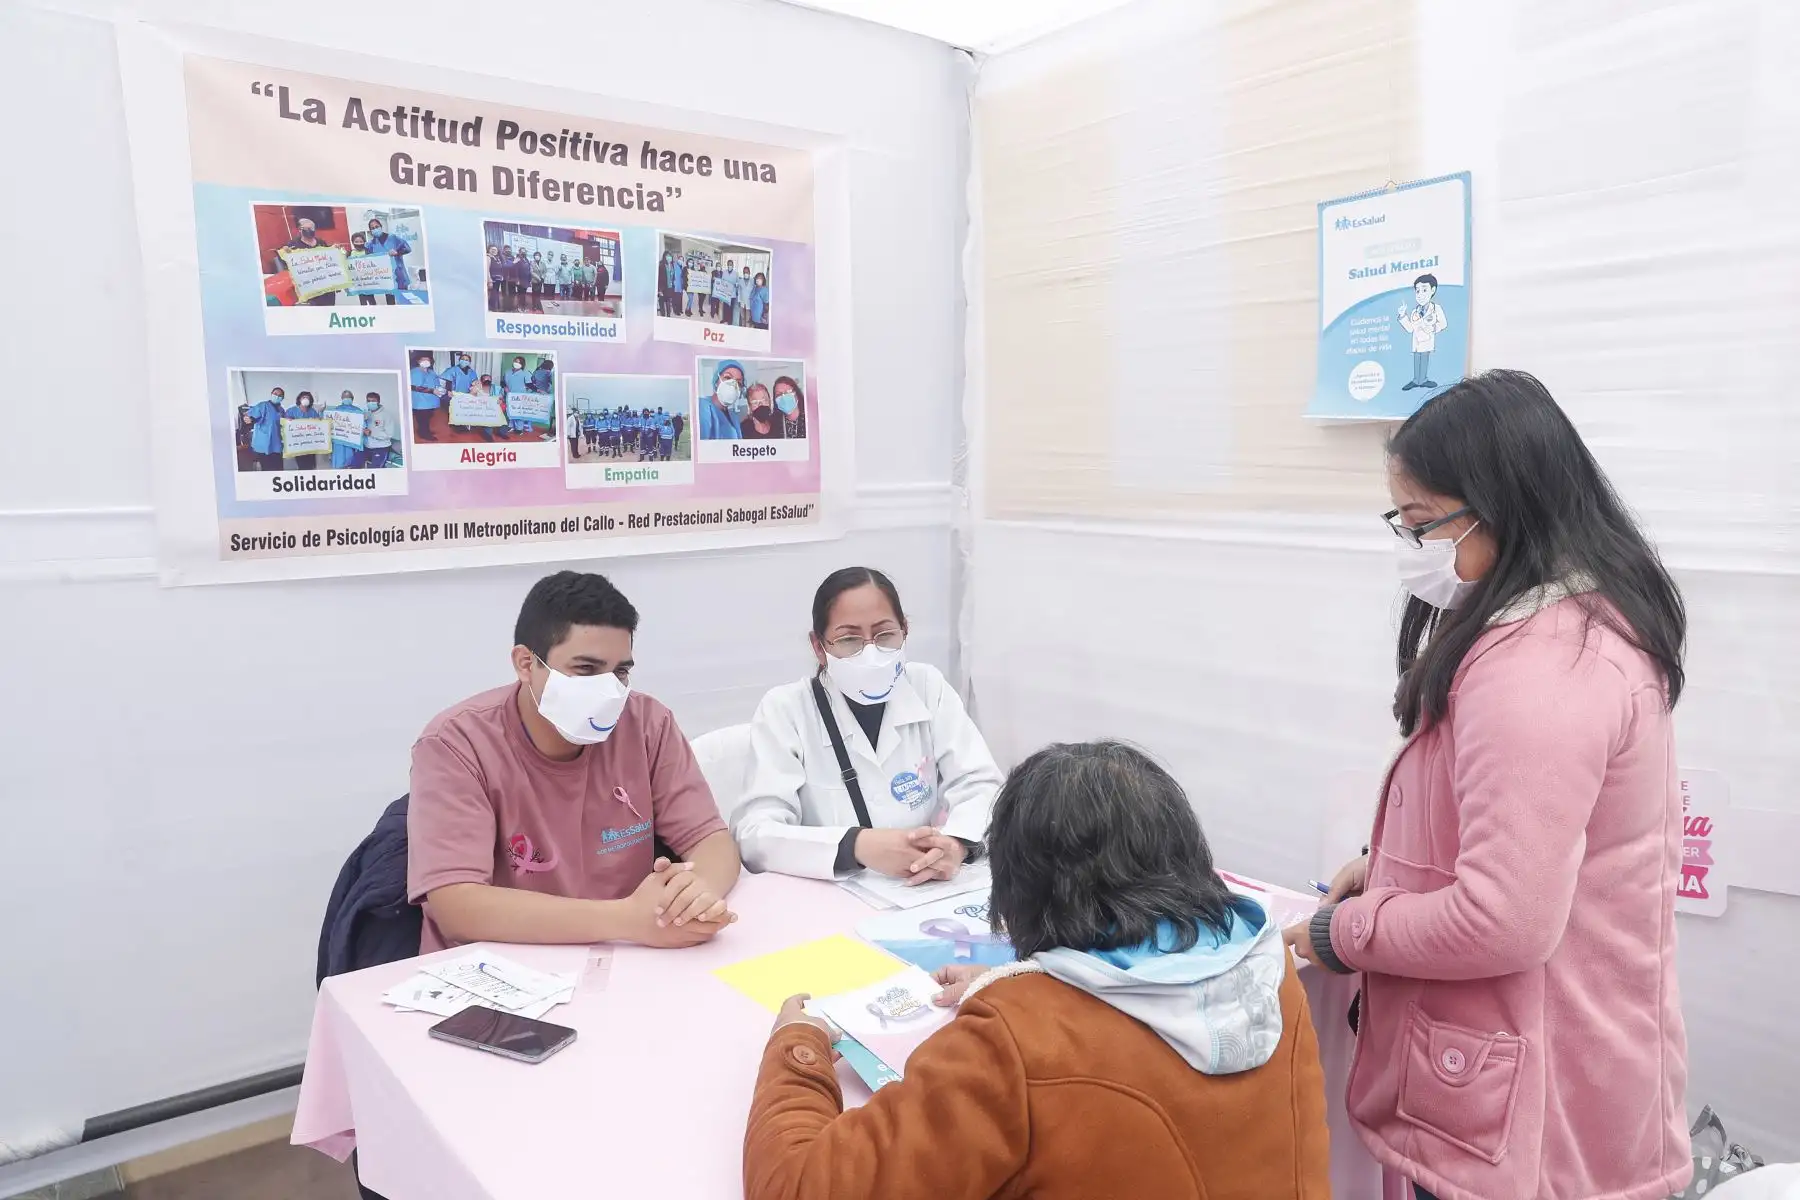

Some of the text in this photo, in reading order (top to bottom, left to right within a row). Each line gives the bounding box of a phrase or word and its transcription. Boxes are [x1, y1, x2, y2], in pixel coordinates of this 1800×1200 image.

[251, 81, 777, 184] “La Actitud Positiva hace una
[389, 152, 683, 213] Gran Diferencia”
[1352, 214, 1386, 229] EsSalud
[1348, 256, 1439, 280] Salud Mental
[328, 312, 376, 328] Amor
[496, 318, 618, 338] Responsabilidad
[703, 327, 725, 343] Paz
[459, 447, 517, 468] Alegría
[732, 444, 778, 461] Respeto
[271, 473, 377, 493] Solidaridad
[604, 466, 660, 485] Empatía
[230, 531, 297, 552] Servicio
[302, 530, 321, 548] de
[326, 525, 405, 548] Psicología
[409, 524, 439, 542] CAP
[444, 522, 459, 540] III
[463, 518, 558, 541] Metropolitano
[560, 516, 580, 533] del
[583, 514, 615, 532] Callo
[628, 513, 650, 529] Red
[654, 508, 723, 528] Prestacional
[726, 505, 768, 526] Sabogal
[771, 502, 815, 520] EsSalud”
